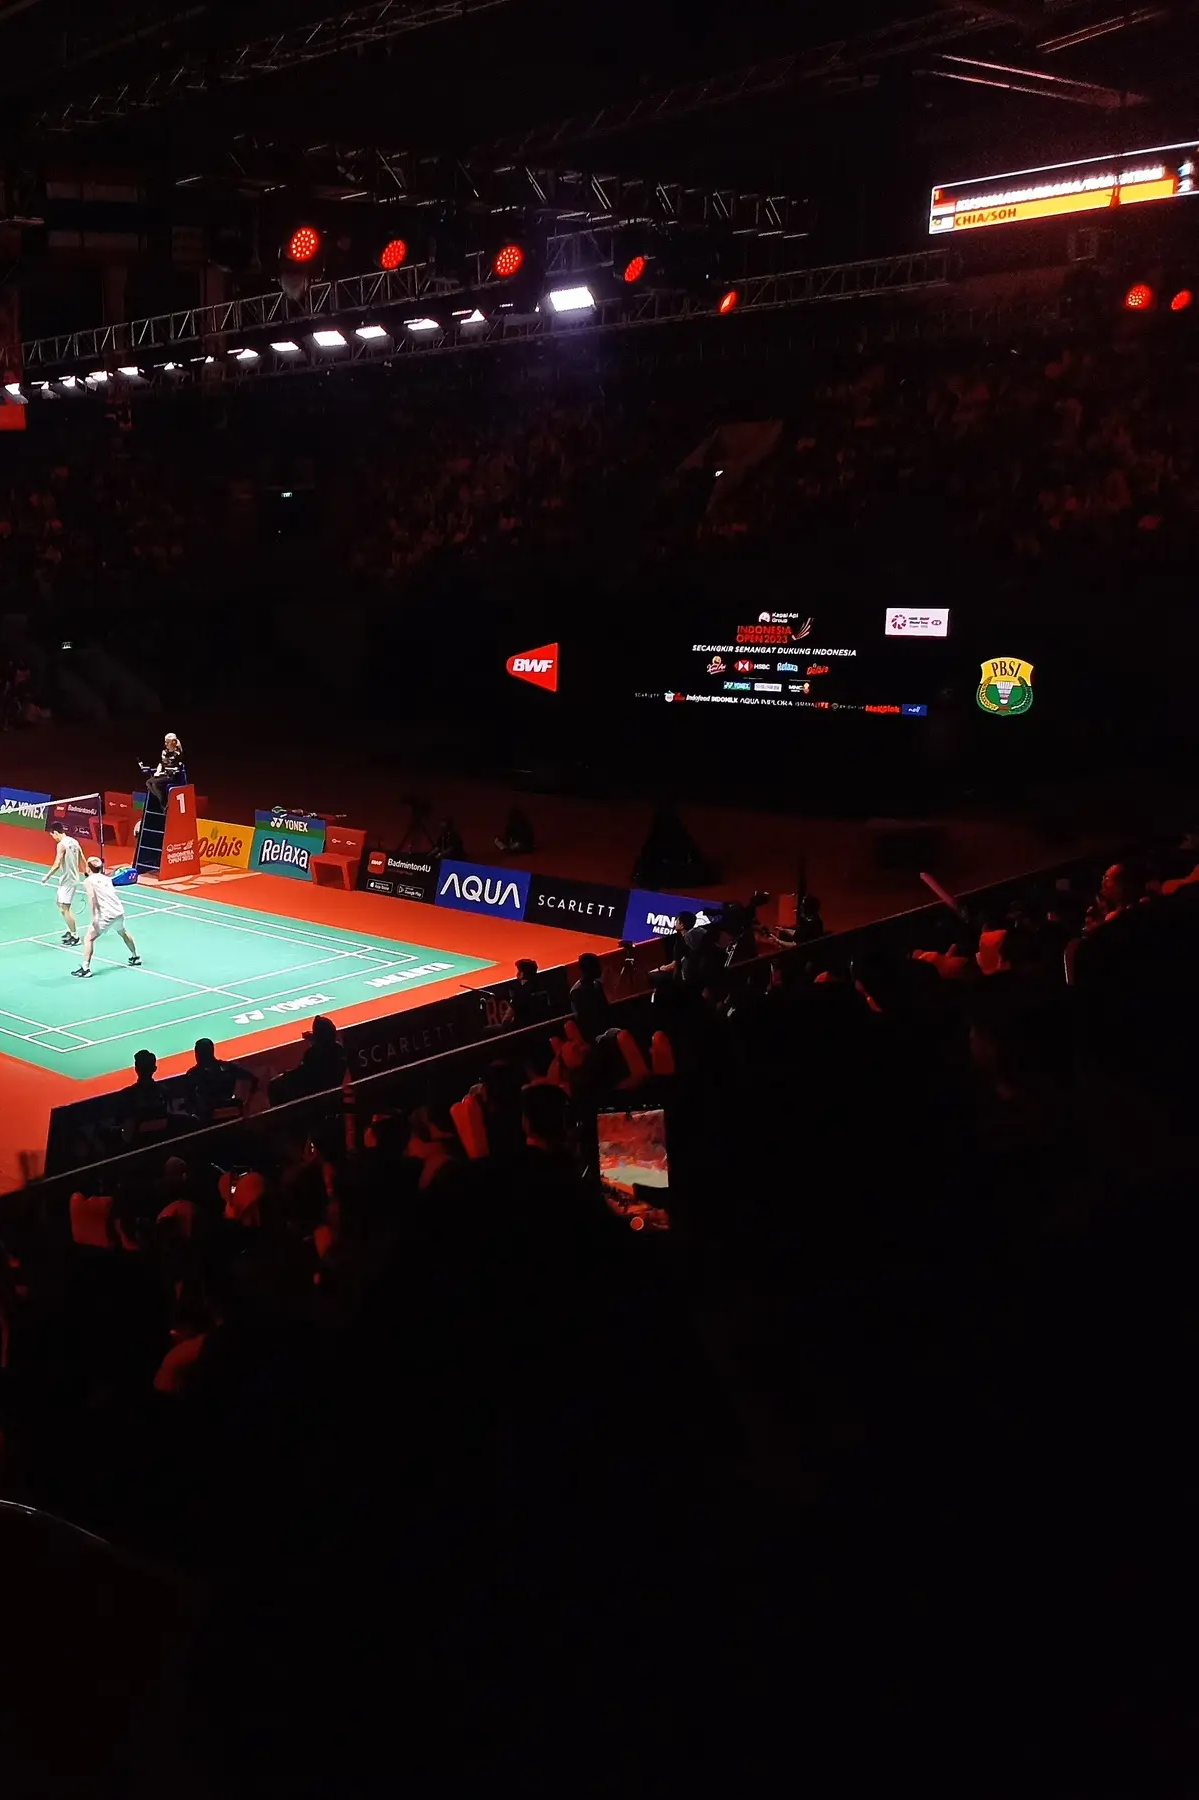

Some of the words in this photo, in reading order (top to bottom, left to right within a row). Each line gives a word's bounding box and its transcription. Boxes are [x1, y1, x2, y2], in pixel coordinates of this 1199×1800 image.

[955, 208, 1017, 226] CHIA/SOH
[737, 625, 792, 635] INDONESIA
[736, 634, 763, 644] OPEN
[764, 634, 788, 644] 2023
[692, 645, 733, 653] SECANGKIR
[735, 646, 776, 654] SEMANGAT
[777, 647, 811, 655] DUKUNG
[812, 649, 857, 657] INDONESIA
[513, 658, 553, 672] BWF
[991, 661, 1021, 677] PBSI
[176, 793, 185, 814] 1
[284, 819, 309, 833] YONEX
[198, 835, 243, 857] Delbis
[261, 839, 308, 869] Relaxa
[388, 858, 431, 873] Badminton4U
[440, 873, 520, 909] AQUA
[538, 894, 615, 918] SCARLETT
[646, 912, 677, 928] MN
[263, 993, 337, 1013] YONEX
[358, 1022, 455, 1067] SCARLETT
